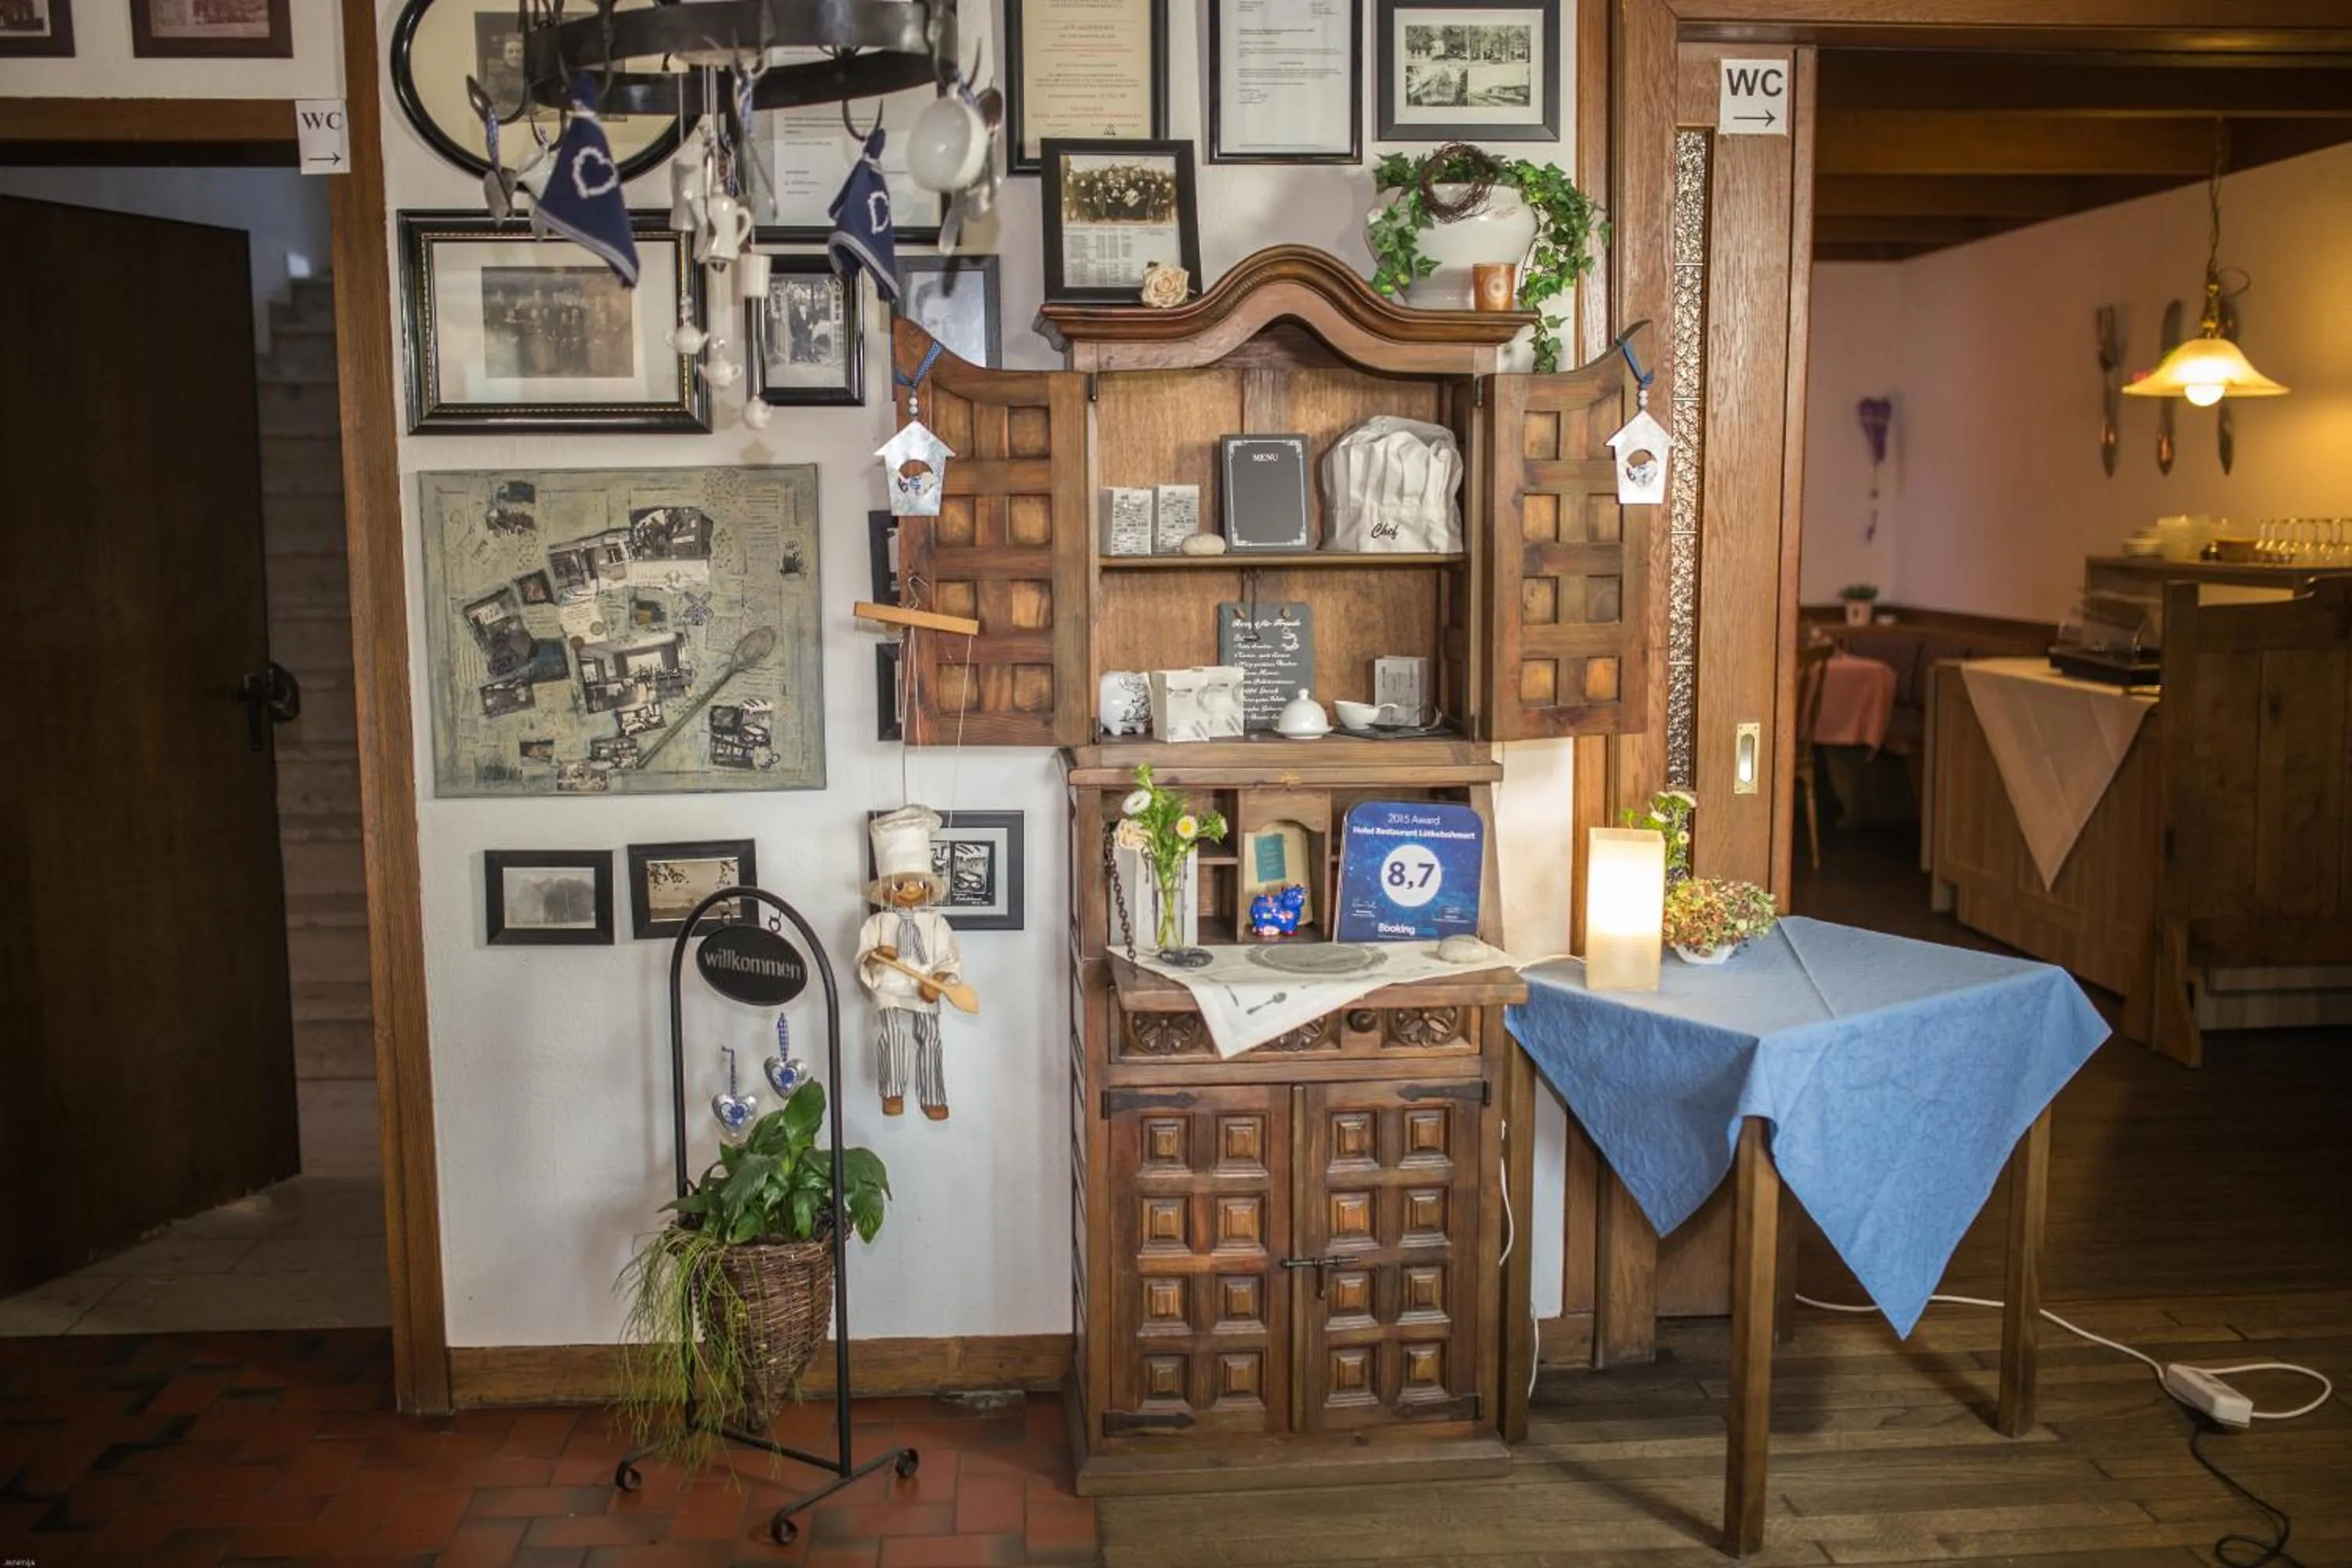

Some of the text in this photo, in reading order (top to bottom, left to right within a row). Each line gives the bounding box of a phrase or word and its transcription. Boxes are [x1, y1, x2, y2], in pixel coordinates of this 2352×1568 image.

[1726, 68, 1783, 97] WC
[301, 112, 343, 130] WC
[1253, 453, 1279, 462] MENU
[1371, 522, 1399, 540] Chef
[1387, 812, 1440, 826] 2015 Award
[1352, 826, 1374, 835] Hotel
[1375, 827, 1417, 837] Restaurant
[1388, 861, 1435, 889] 8,7
[706, 948, 800, 979] willkommen
